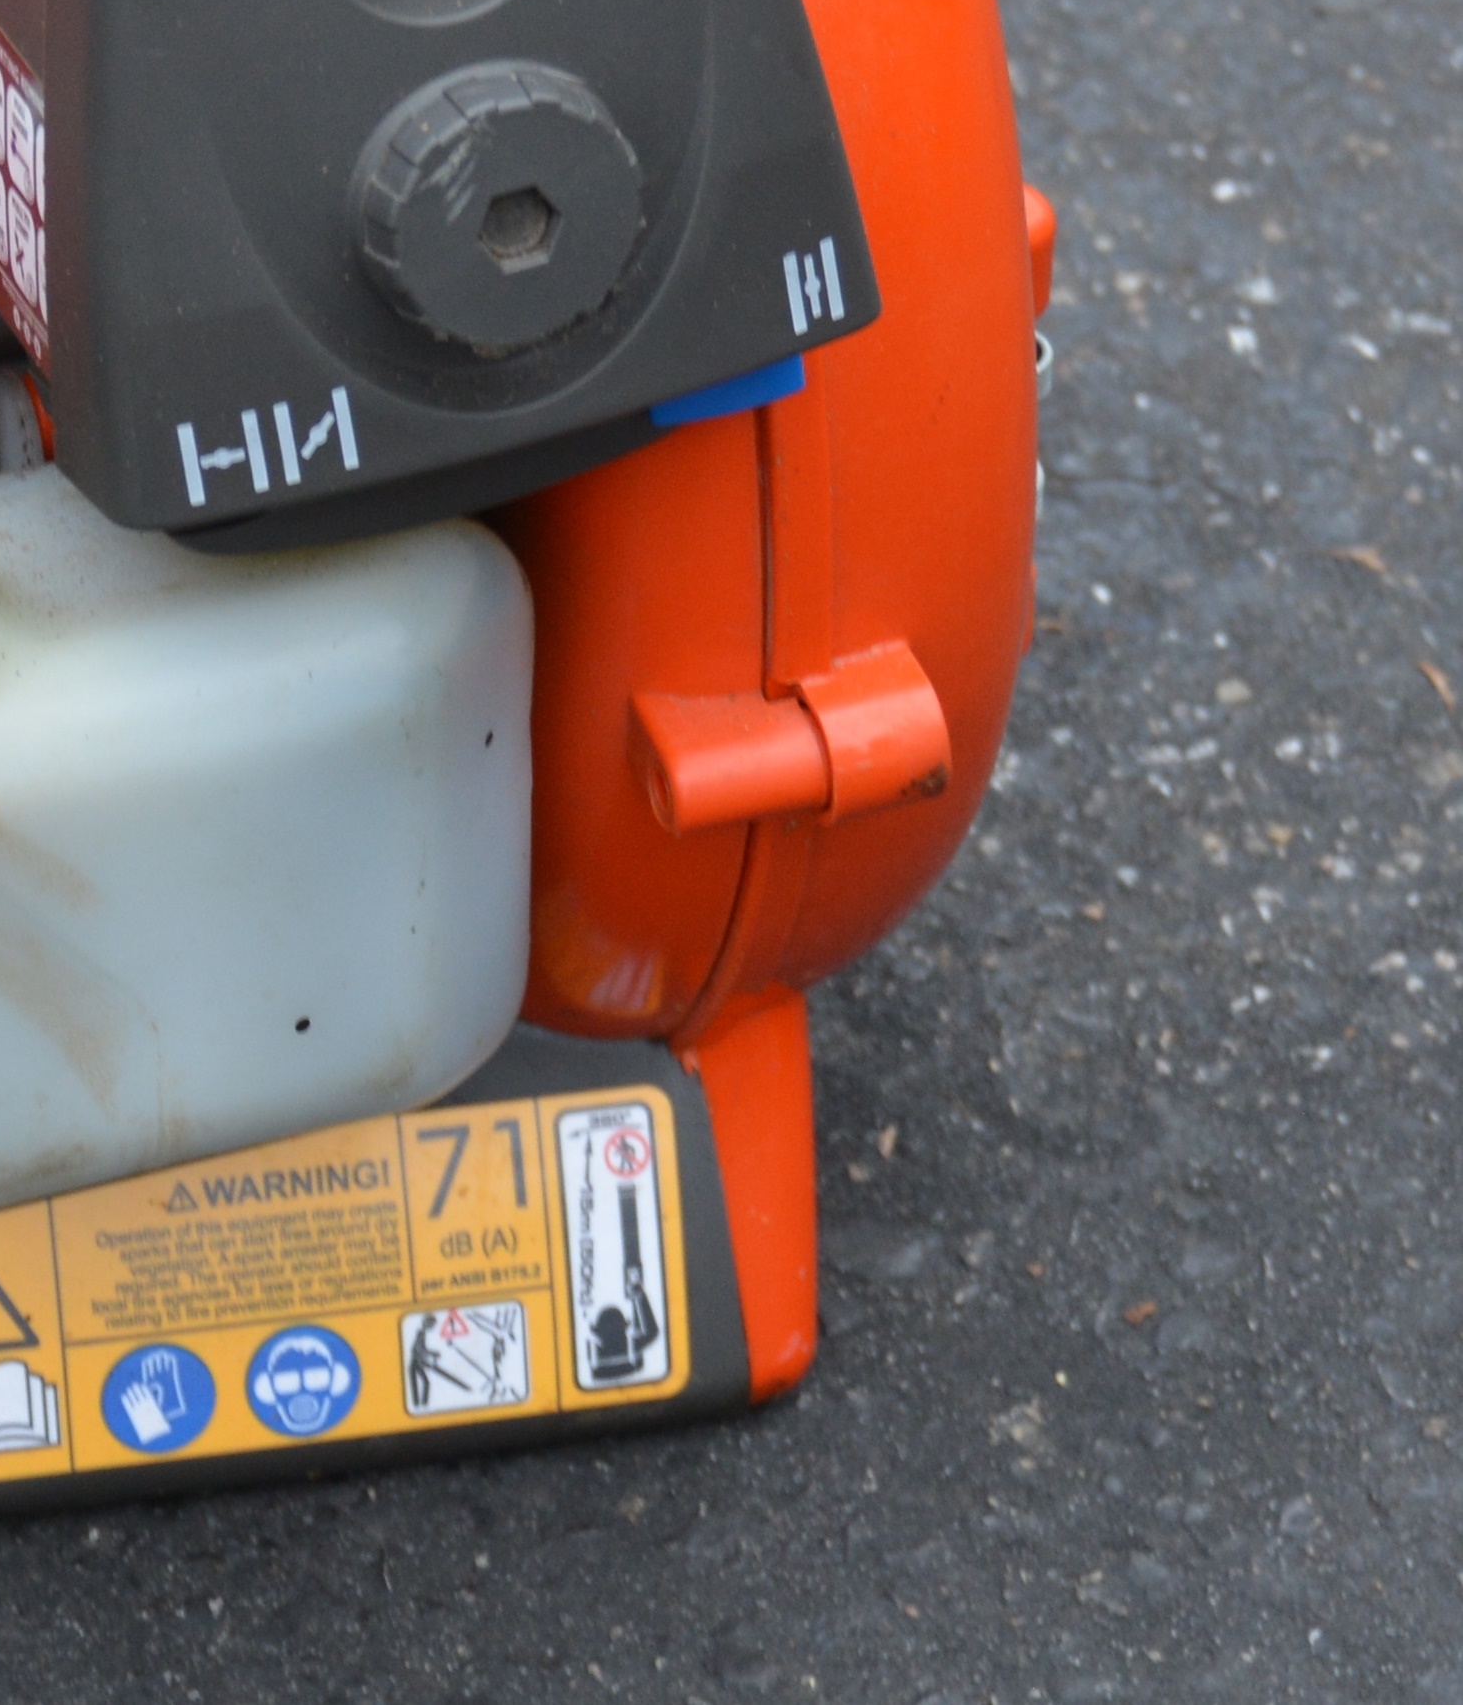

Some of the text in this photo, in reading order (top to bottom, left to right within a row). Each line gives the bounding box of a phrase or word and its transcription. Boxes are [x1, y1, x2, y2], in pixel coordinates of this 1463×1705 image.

[201, 1158, 390, 1208] WARNING!
[417, 1118, 527, 1220] 71
[440, 1224, 518, 1259] dB (A)
